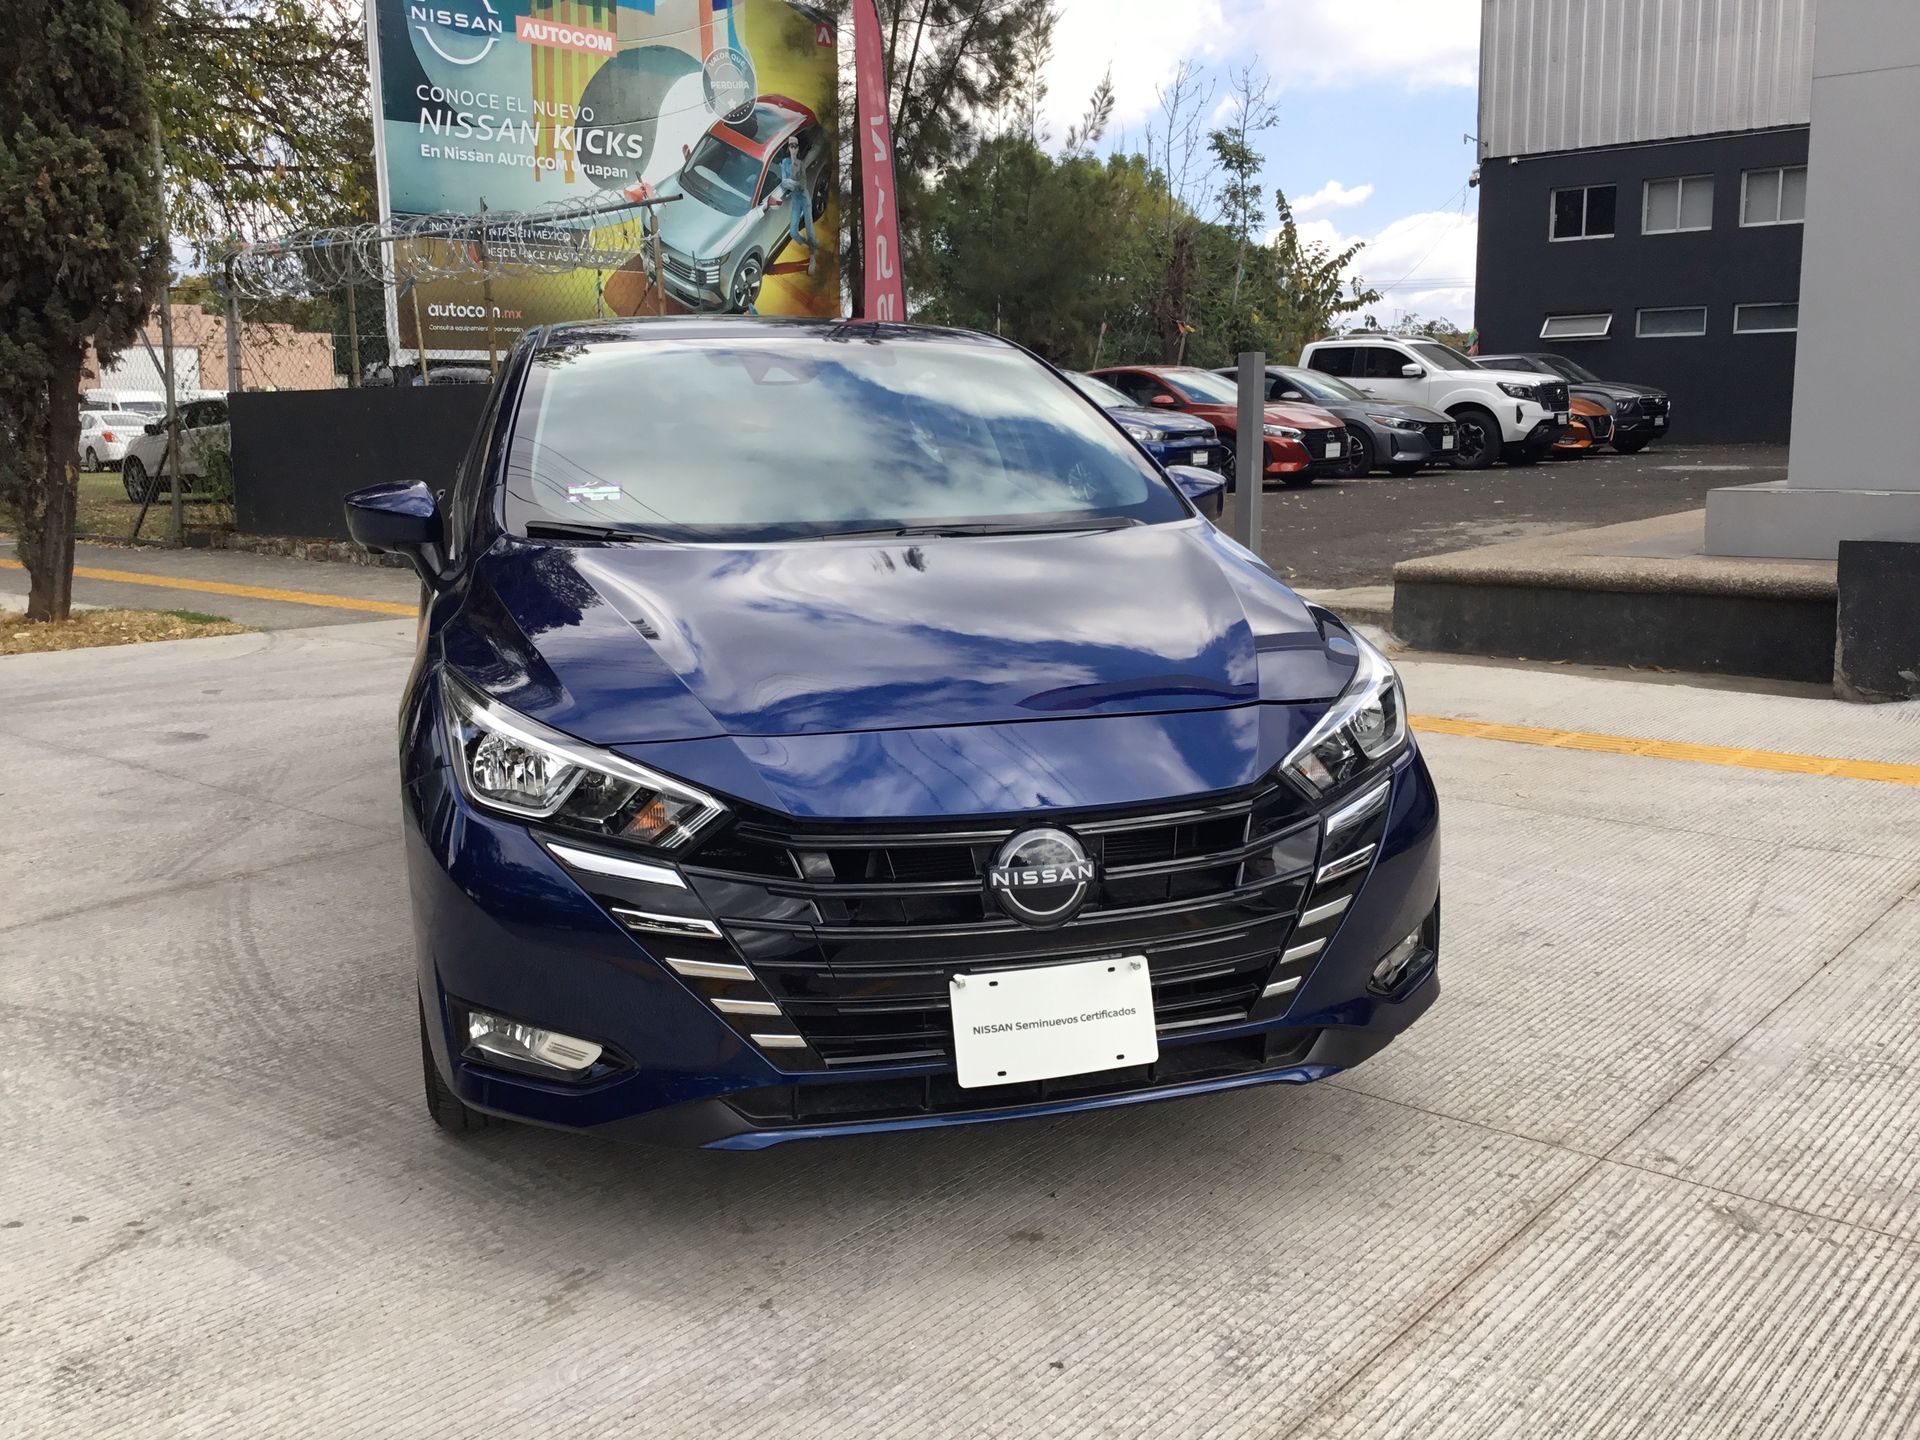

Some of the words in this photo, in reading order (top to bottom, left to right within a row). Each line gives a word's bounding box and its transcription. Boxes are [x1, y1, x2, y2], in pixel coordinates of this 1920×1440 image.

[411, 5, 502, 34] NISSAN
[522, 22, 613, 52] AUTOCOM
[708, 51, 730, 68] VALOR
[731, 53, 746, 68] QUE
[710, 80, 751, 90] PERDURA
[416, 84, 499, 110] CONOCE
[506, 97, 528, 114] EL
[533, 100, 595, 123] NUEVO
[419, 107, 541, 147] NISSAN
[553, 123, 644, 160] KICKS
[420, 143, 441, 159] En
[444, 146, 494, 164] Nissan
[497, 151, 568, 172] AUTOCOM
[571, 161, 628, 179] Uruapan
[533, 227, 571, 241] MÉXICO
[992, 863, 1094, 886] NISSAN
[973, 1021, 1013, 1036] NISSAN
[1015, 1014, 1079, 1031] Seminuevos
[1080, 1007, 1136, 1023] Certificados
